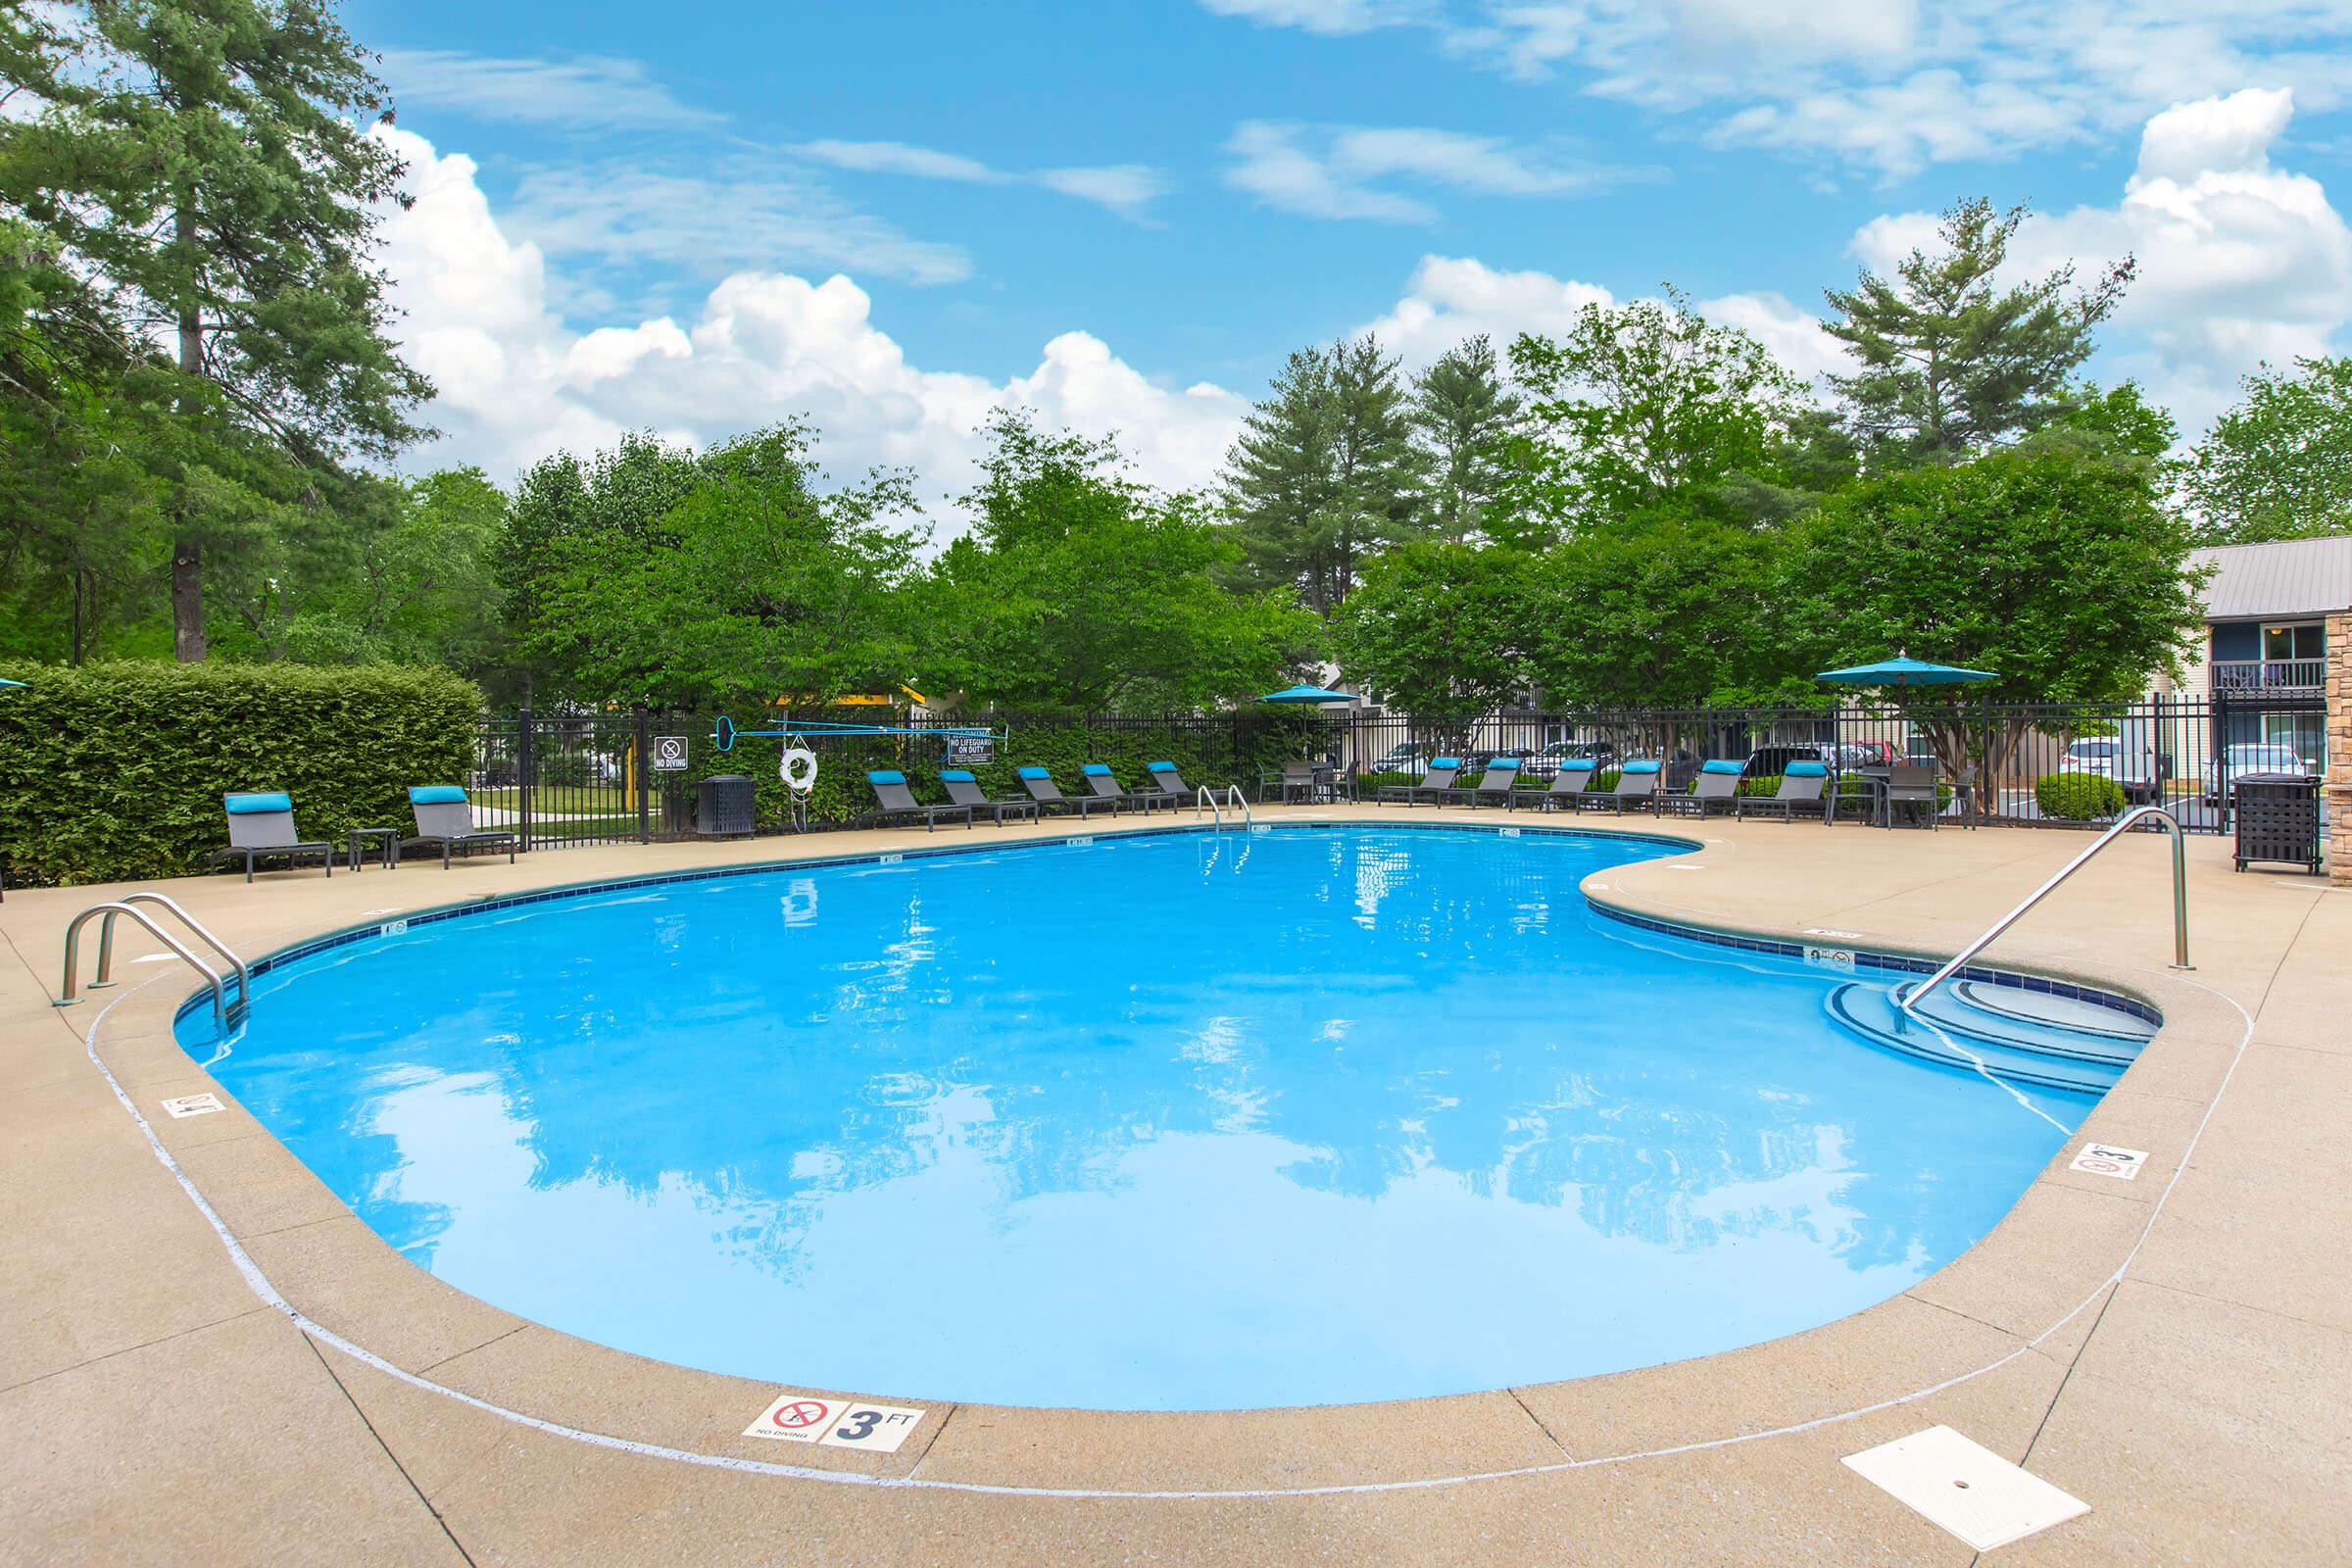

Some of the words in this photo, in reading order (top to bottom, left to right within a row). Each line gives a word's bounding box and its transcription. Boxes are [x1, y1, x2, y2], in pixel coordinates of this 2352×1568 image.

[656, 759, 665, 767] NO
[666, 759, 686, 767] DIVING
[2091, 1150, 2134, 1161] 3
[836, 1410, 884, 1441] 3
[885, 1412, 914, 1427] FT
[773, 1430, 808, 1439] DIVING
